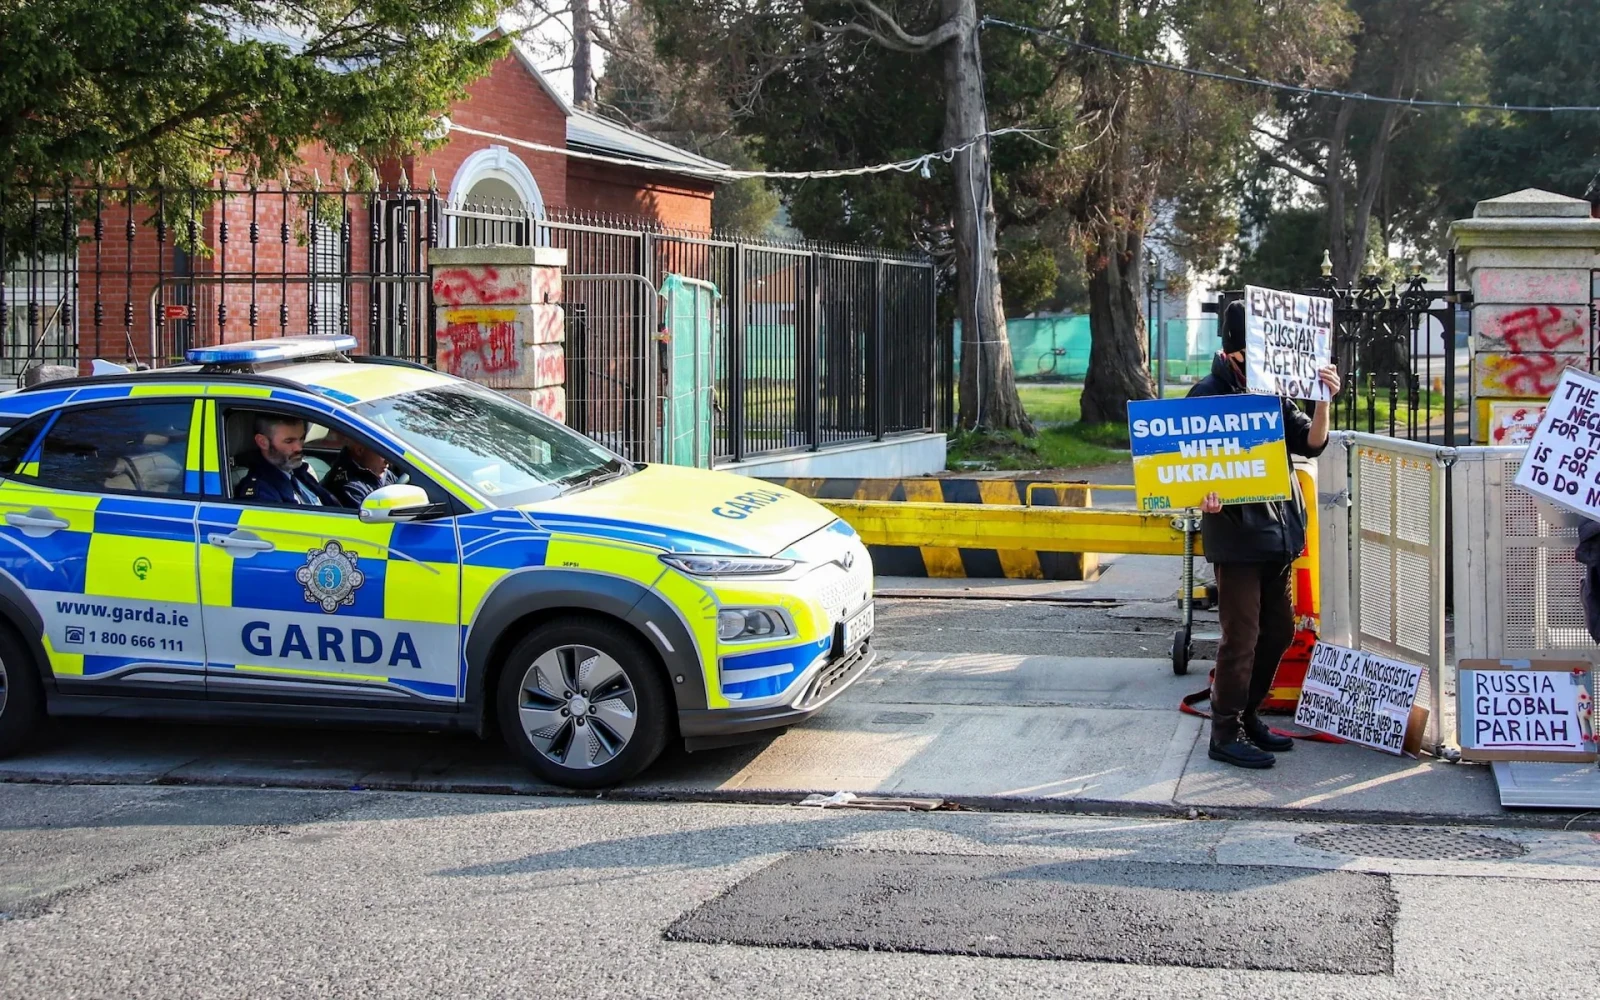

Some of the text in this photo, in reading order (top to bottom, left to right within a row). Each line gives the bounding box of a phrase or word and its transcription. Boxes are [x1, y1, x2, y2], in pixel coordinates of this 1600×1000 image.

[1250, 288, 1331, 329] EXPEL ALL
[1263, 321, 1316, 353] RUSSIAN
[1263, 345, 1317, 380] AGENTS
[1565, 380, 1599, 409] THE
[1132, 411, 1280, 438] SOLIDARITY
[1548, 417, 1600, 451] FOR T
[1178, 437, 1240, 458] WITH
[1573, 446, 1598, 463] OF
[1157, 459, 1267, 484] UKRAINE
[1530, 464, 1549, 486] TO
[1553, 473, 1579, 496] DO
[1558, 454, 1589, 480] FOR
[711, 488, 791, 520] GARDA
[56, 601, 189, 627] www.garda.ie
[89, 631, 183, 652] 1 800 666 111
[241, 621, 422, 669] GARDA
[1311, 643, 1340, 668] PUTIN
[1350, 656, 1360, 674] A
[1476, 672, 1555, 695] RUSSIA
[1312, 693, 1325, 710] THE
[1324, 696, 1350, 718] RUSSIAN
[1393, 720, 1403, 734] TO
[1476, 696, 1569, 716] GLOBAL
[1297, 707, 1316, 726] STOP
[1337, 716, 1363, 740] BEFORE
[1476, 718, 1568, 744] PARIAH
